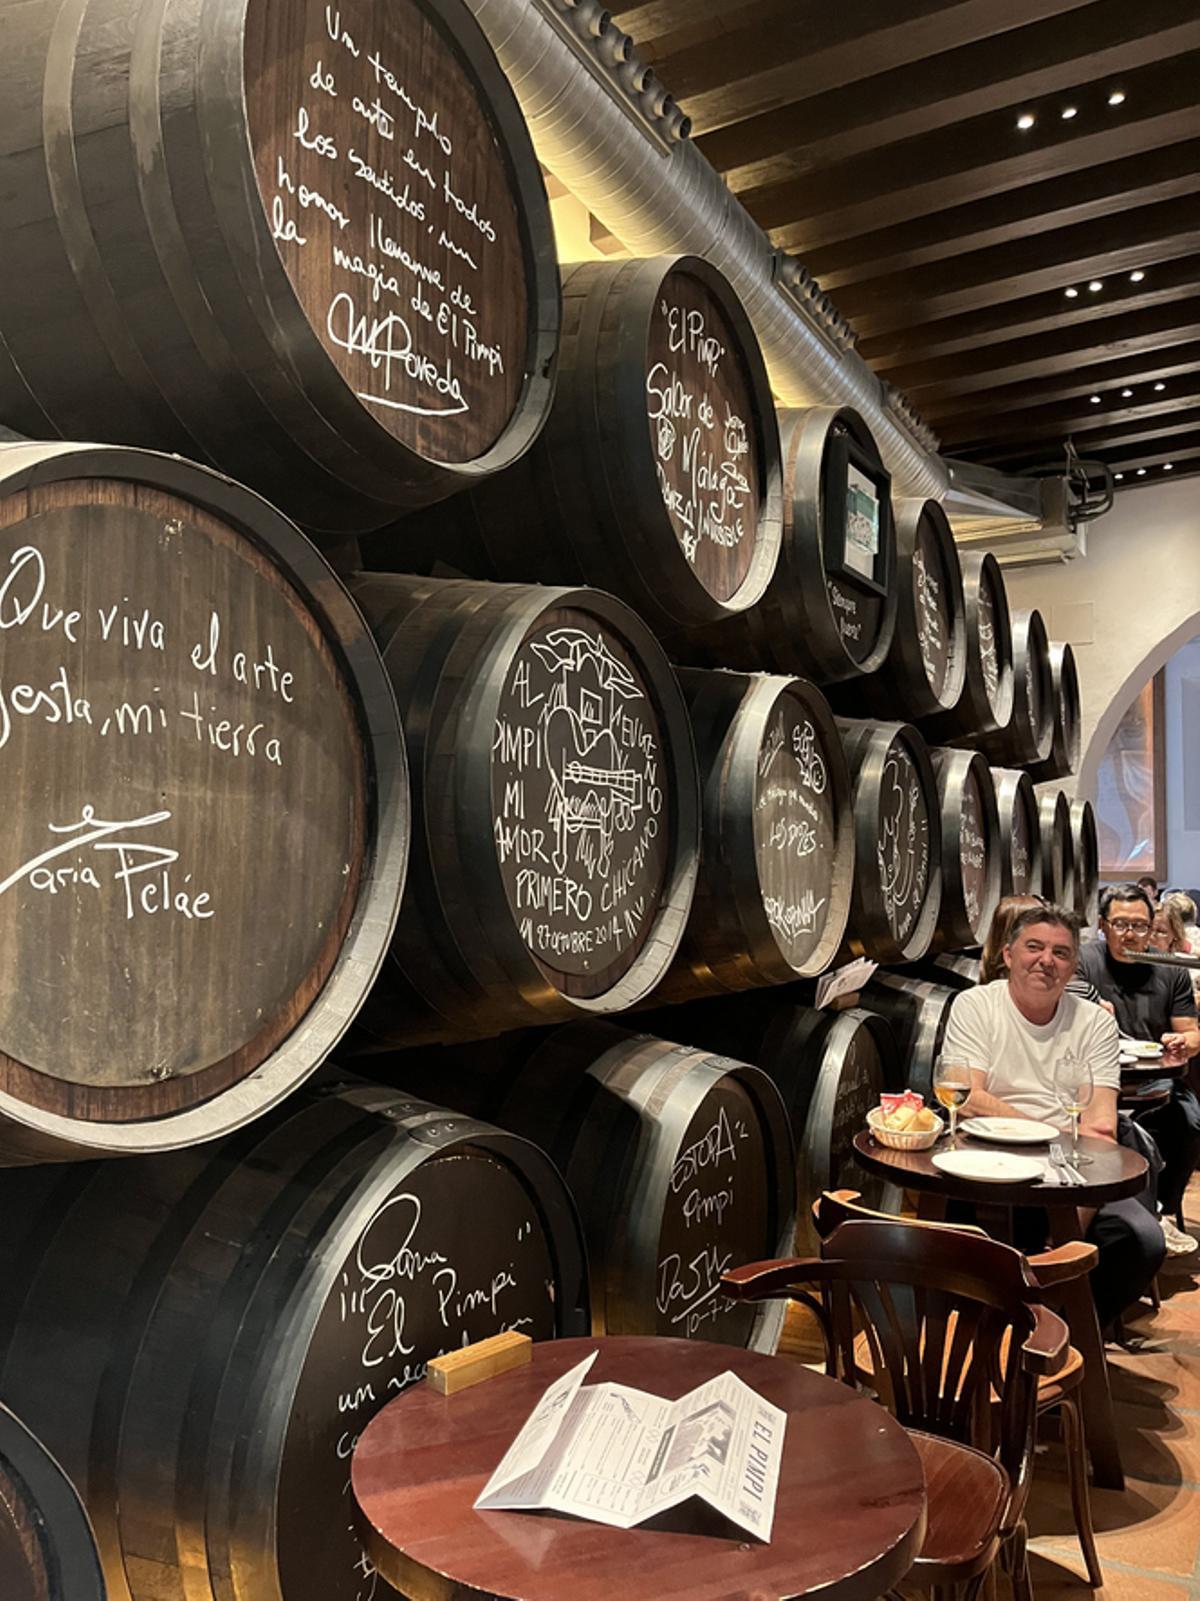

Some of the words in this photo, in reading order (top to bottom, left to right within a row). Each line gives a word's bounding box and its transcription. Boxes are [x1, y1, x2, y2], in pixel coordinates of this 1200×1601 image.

[325, 5, 360, 58] Un
[293, 107, 338, 160] los
[309, 60, 338, 97] de
[402, 149, 437, 189] en
[443, 170, 496, 242] todos
[278, 155, 350, 230] honor
[450, 285, 477, 314] de
[333, 245, 400, 302] magia
[411, 281, 433, 322] de
[437, 302, 458, 348] El
[462, 318, 503, 377] Pimpi
[698, 392, 714, 429] de
[0, 546, 81, 643] Que
[99, 597, 165, 651] viva
[190, 612, 219, 675] el
[233, 645, 294, 702] arte
[511, 660, 545, 708] AL
[180, 691, 282, 766] tierra
[503, 779, 525, 819] MI
[494, 816, 550, 863] AMOR
[515, 869, 593, 922] PRIMERO
[361, 1288, 414, 1367] El
[432, 1264, 516, 1327] Pimpi
[752, 1420, 773, 1445] EL
[742, 1443, 769, 1501] PIMPI
